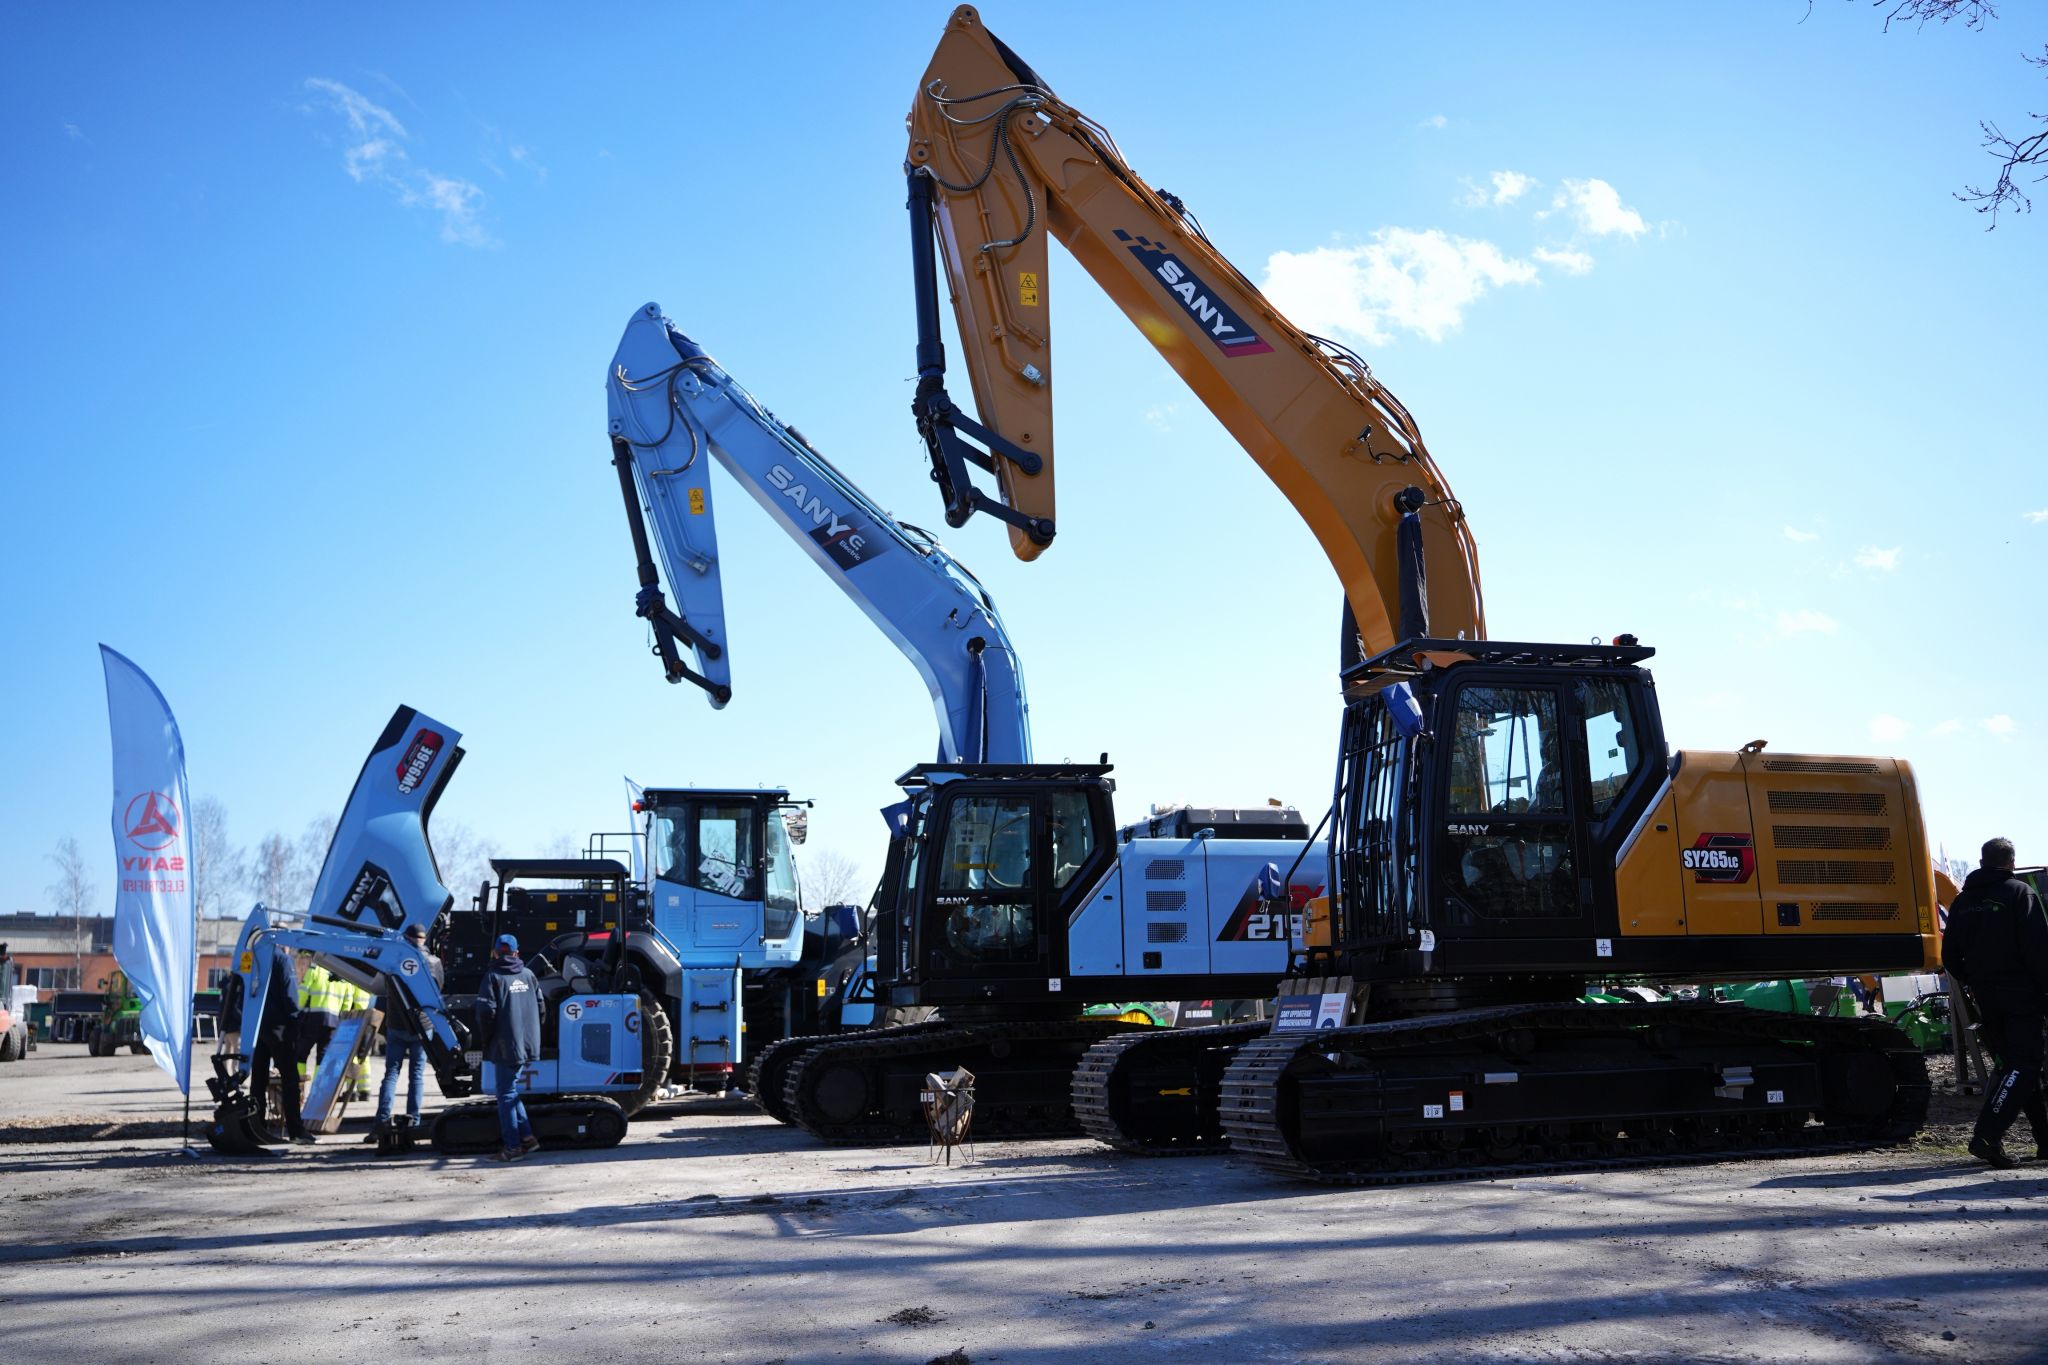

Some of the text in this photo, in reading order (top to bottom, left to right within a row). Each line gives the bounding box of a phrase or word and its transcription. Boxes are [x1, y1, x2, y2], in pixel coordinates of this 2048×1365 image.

[1156, 260, 1236, 336] SANY
[765, 464, 852, 537] SANY
[838, 539, 862, 561] Electric
[398, 745, 434, 794] SW956E
[1447, 824, 1490, 836] SANY
[1683, 849, 1739, 868] SY265LC
[345, 871, 373, 915] SANY
[936, 896, 970, 905] SANY
[402, 959, 418, 975] GT
[566, 1004, 582, 1019] GT
[2004, 1069, 2020, 1088] LKQ
